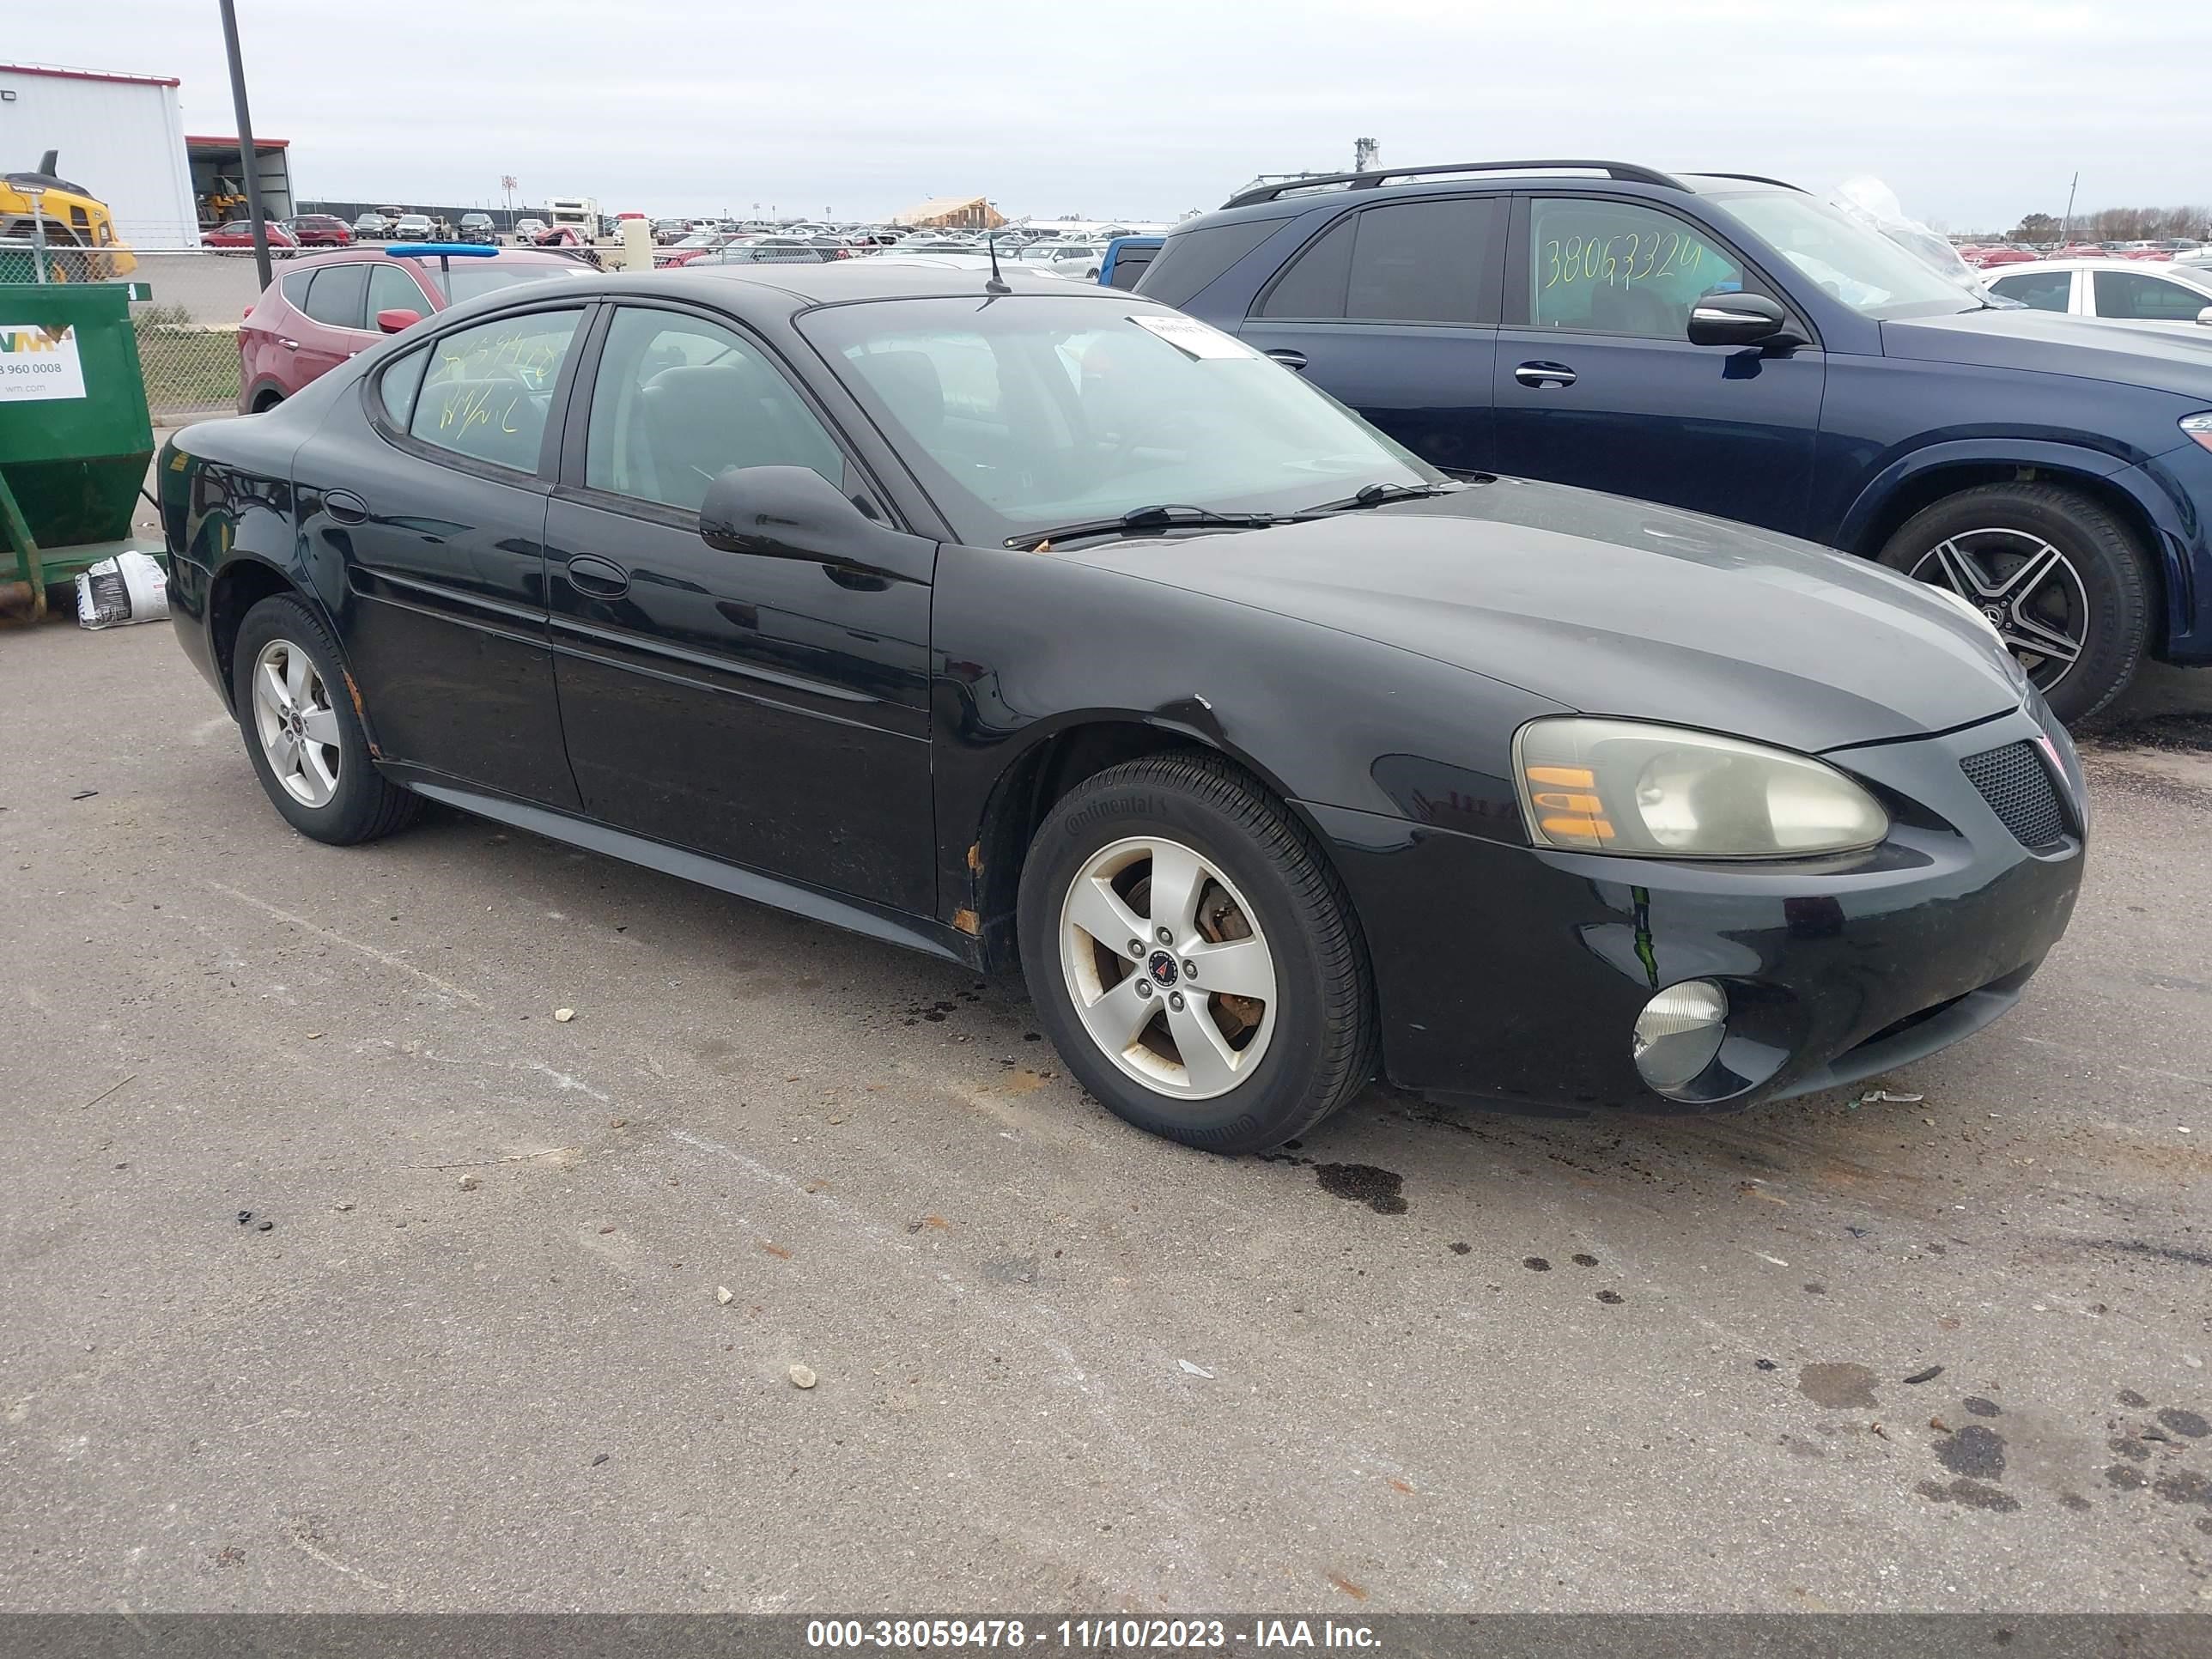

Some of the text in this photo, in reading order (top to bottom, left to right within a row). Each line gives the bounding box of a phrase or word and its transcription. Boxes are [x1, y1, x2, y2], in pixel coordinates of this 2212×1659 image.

[7, 364, 30, 374] 960
[33, 363, 62, 374] 0008
[5, 385, 47, 393] wm.com
[1065, 794, 1153, 836] Continental
